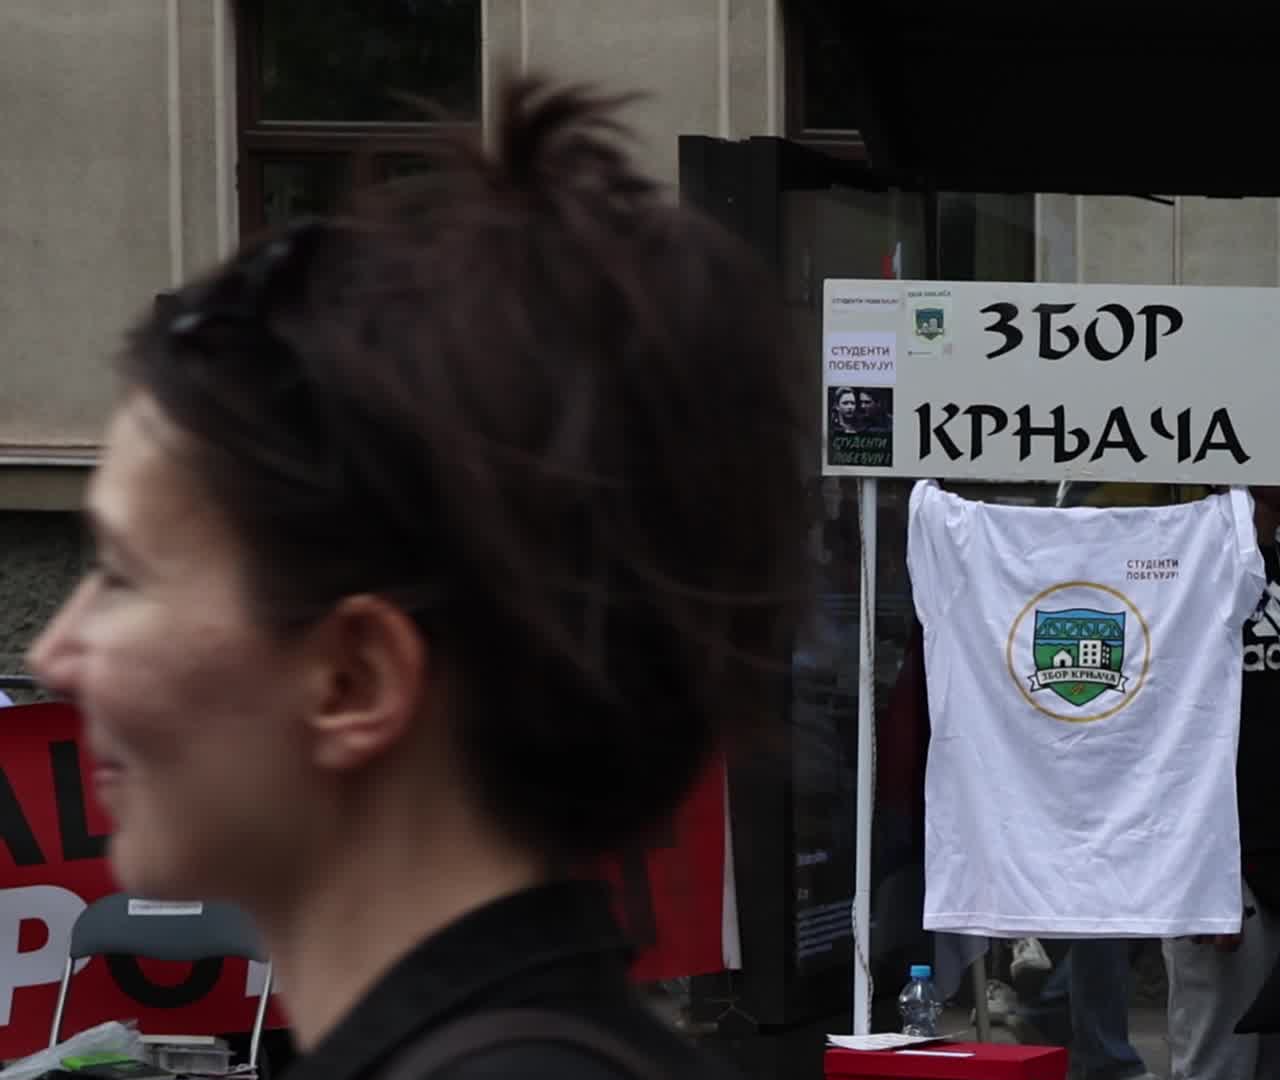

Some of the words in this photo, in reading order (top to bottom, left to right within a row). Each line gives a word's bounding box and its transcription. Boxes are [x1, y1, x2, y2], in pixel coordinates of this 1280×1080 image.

[979, 302, 1184, 362] ЗБОР
[831, 346, 890, 357] СТУДЕНТИ
[828, 360, 894, 371] ПОБЕЂУЈУ!
[914, 401, 1252, 466] КРЊАЧА
[1126, 559, 1179, 570] СТУДЕНТИ
[1041, 669, 1069, 682] ЗБОР
[1071, 670, 1117, 682] КРЊАЧА
